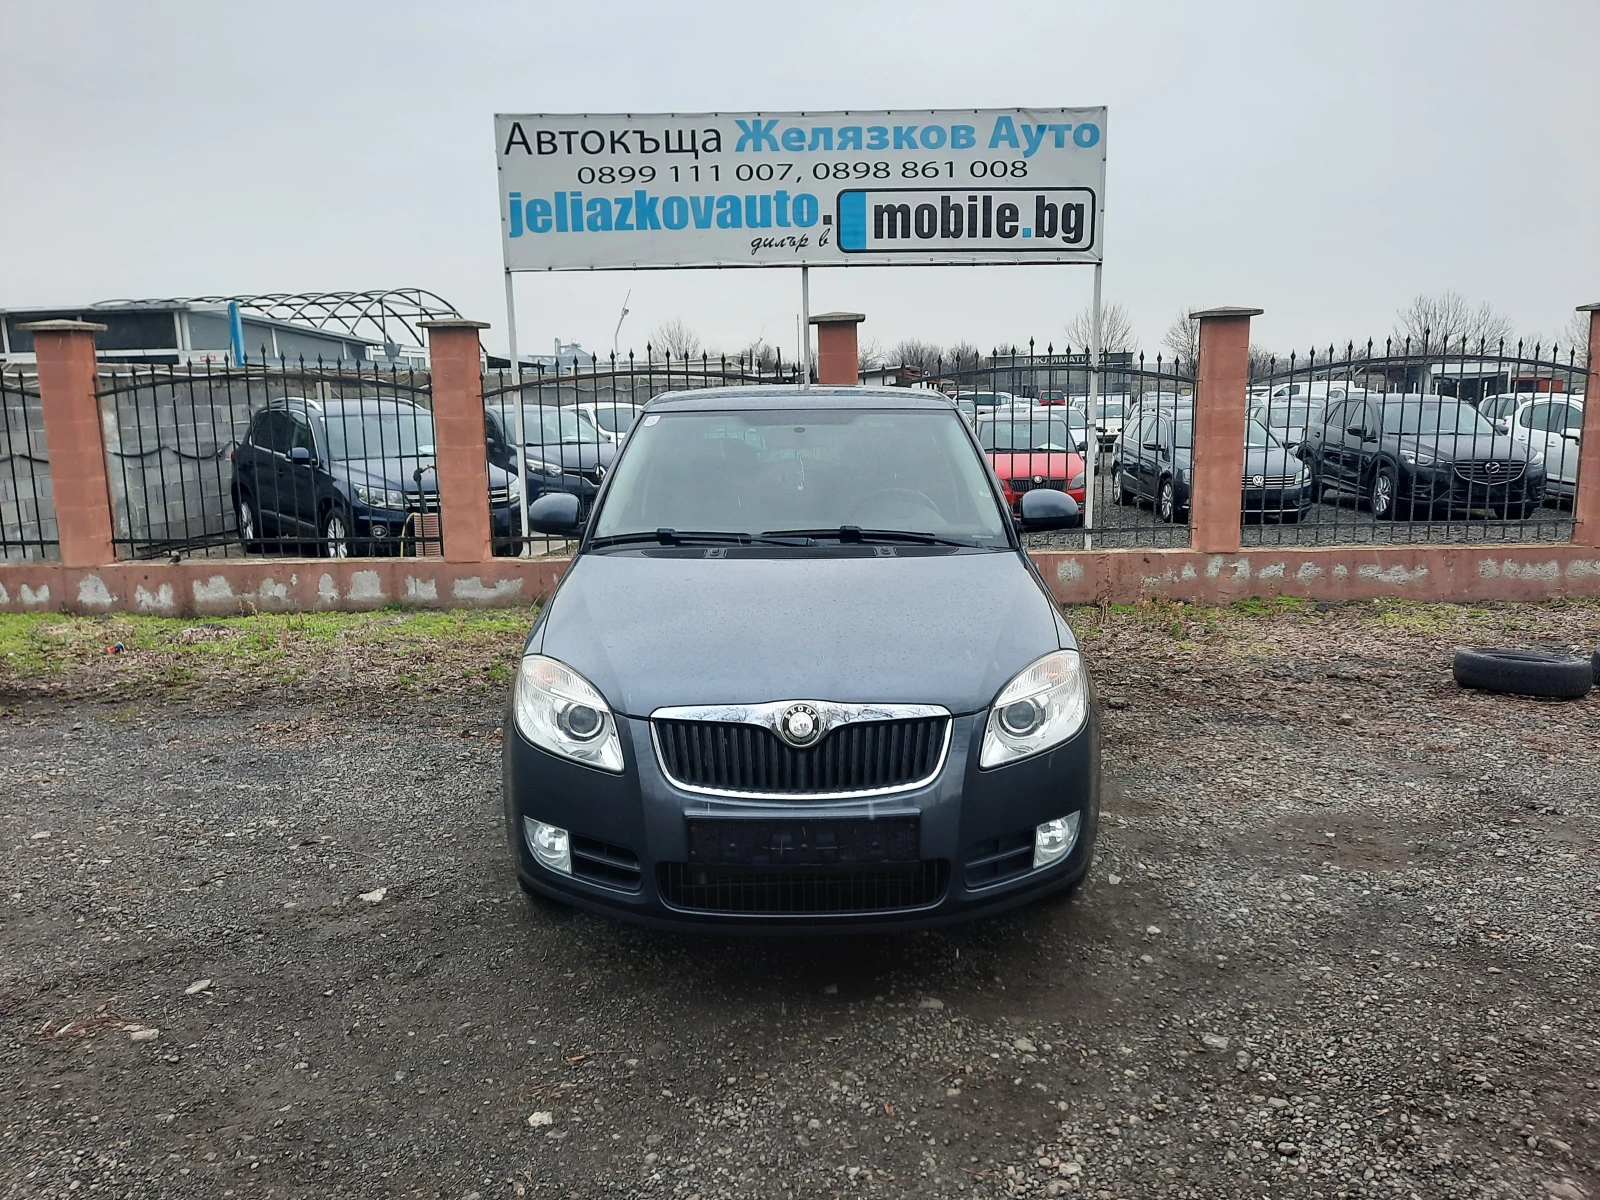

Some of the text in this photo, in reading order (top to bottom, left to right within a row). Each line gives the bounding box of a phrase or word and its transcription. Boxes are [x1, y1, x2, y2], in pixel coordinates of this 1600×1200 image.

[734, 118, 977, 152] Желязков
[988, 115, 1101, 158] Ауто
[577, 160, 1029, 185] 0899 111 007, 0898 861 008
[873, 195, 1085, 244] mobile.bg
[750, 233, 809, 256] дилър
